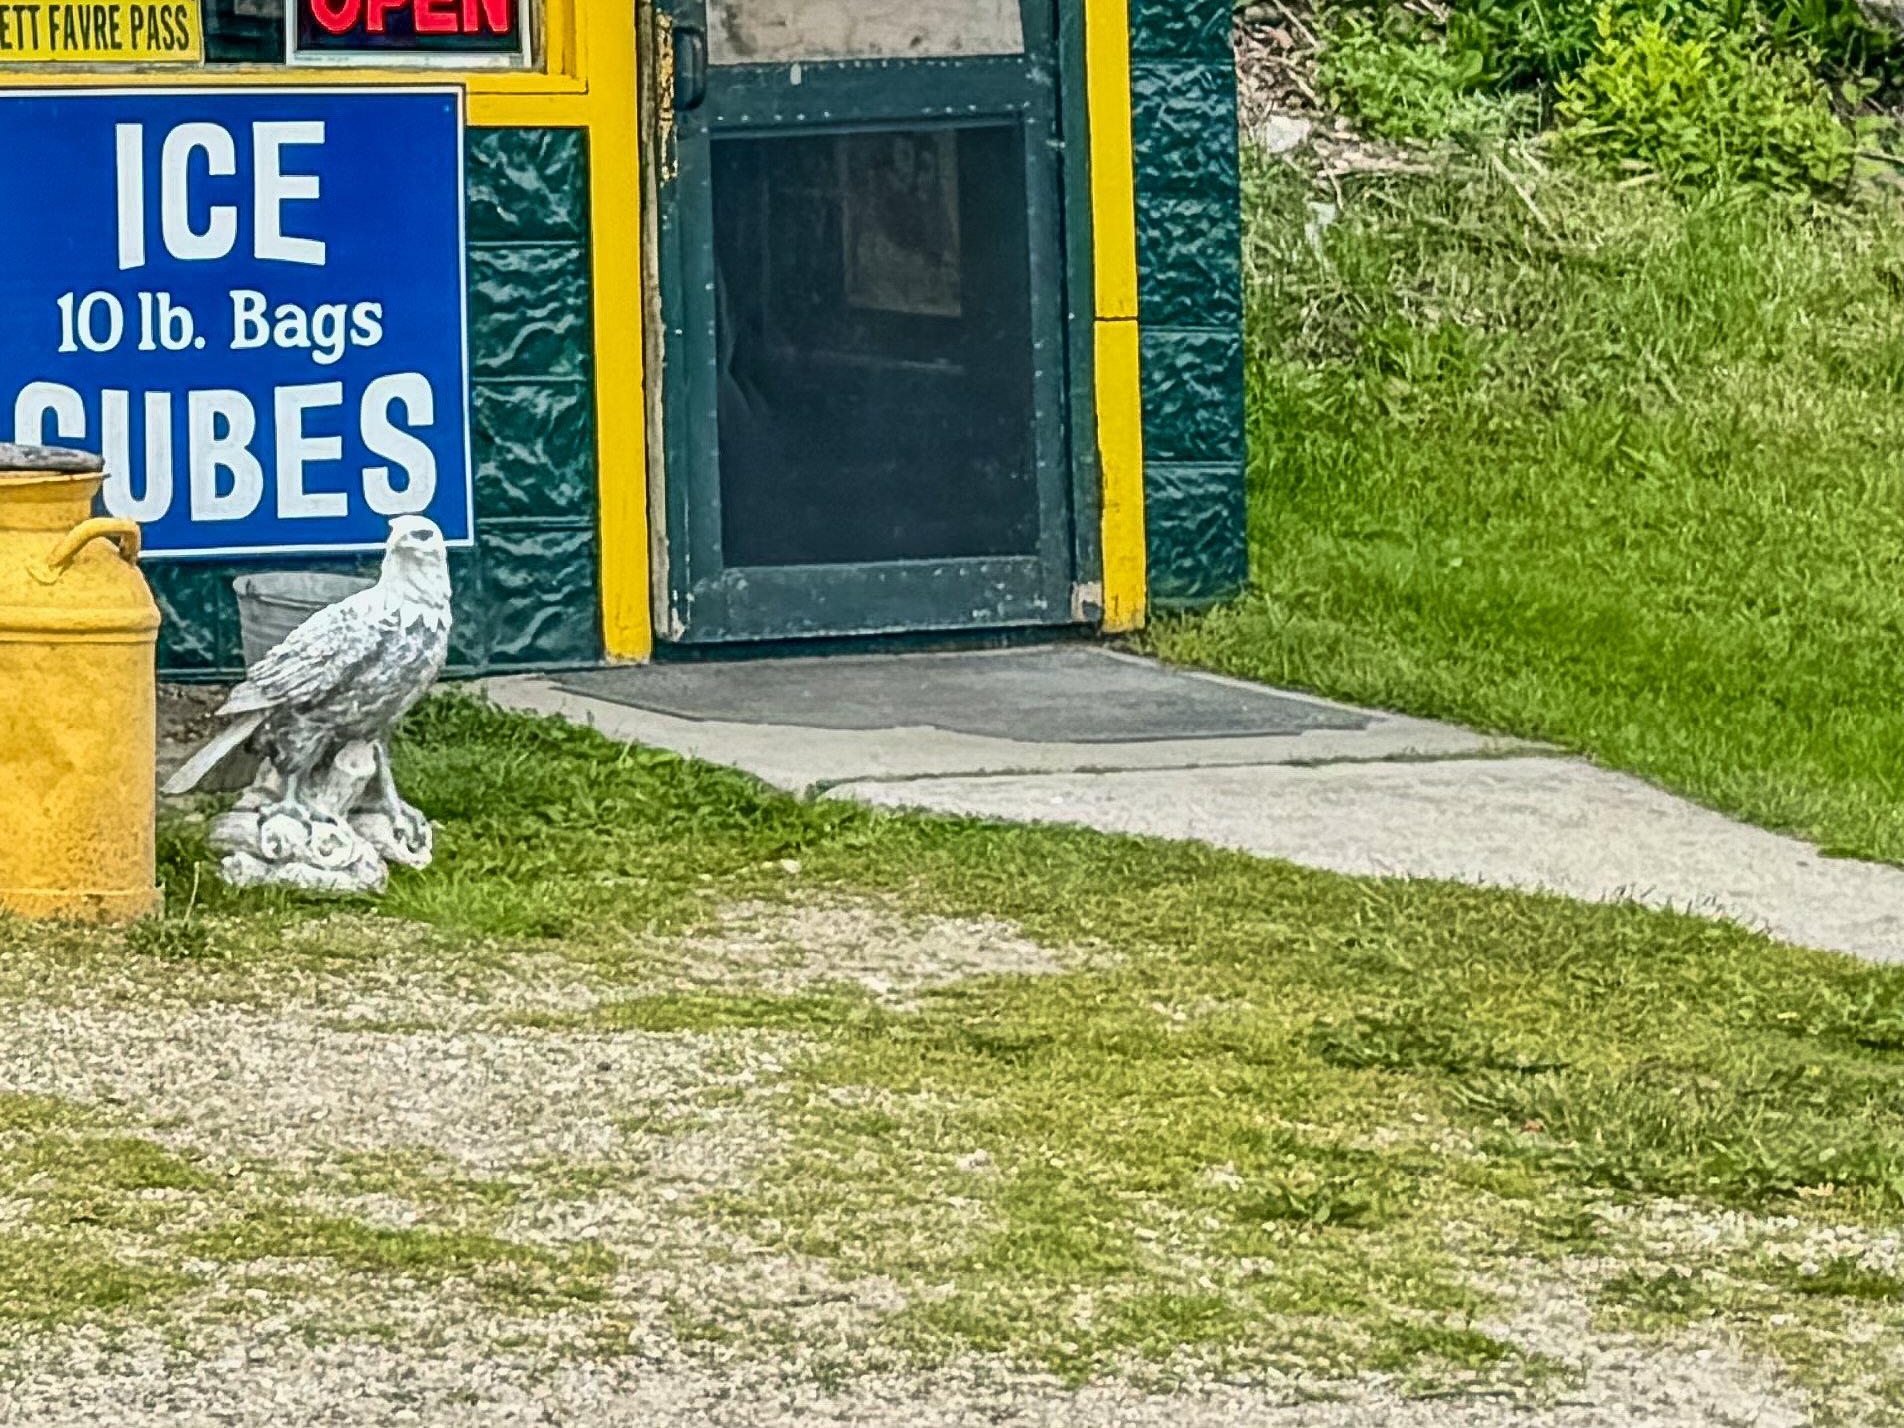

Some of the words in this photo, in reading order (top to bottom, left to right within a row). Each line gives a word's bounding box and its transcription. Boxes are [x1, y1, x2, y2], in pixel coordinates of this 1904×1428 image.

[48, 4, 123, 51] FAVRE
[130, 4, 190, 51] PASS
[114, 120, 327, 270] ICE
[57, 290, 124, 354] 10
[139, 290, 207, 352] lb.
[229, 289, 384, 365] Bags
